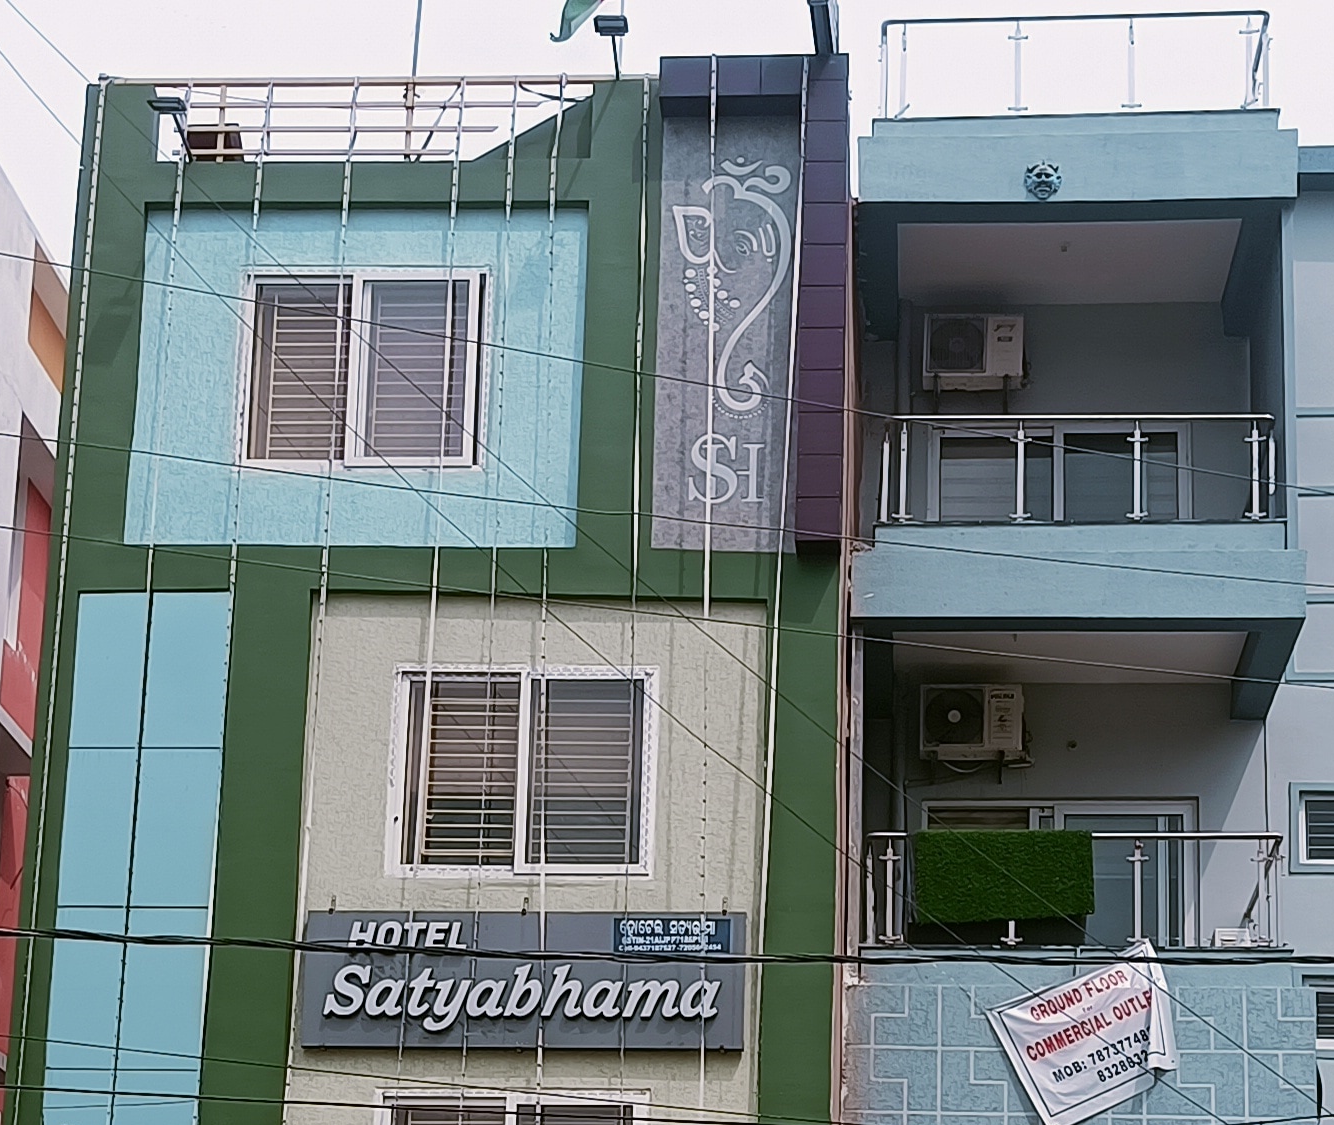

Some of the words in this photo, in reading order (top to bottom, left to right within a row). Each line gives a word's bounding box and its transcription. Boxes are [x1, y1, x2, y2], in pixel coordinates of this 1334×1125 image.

[348, 921, 468, 949] HOTEL
[323, 963, 719, 1031] Satyabhama
[1030, 988, 1083, 1021] GROUND
[1083, 970, 1128, 997] FLOOR
[1027, 1013, 1112, 1061] COMMERCIAL
[1113, 988, 1152, 1020] OUTLE
[1053, 1060, 1087, 1082] MOB:
[1087, 1025, 1151, 1065] 78737748
